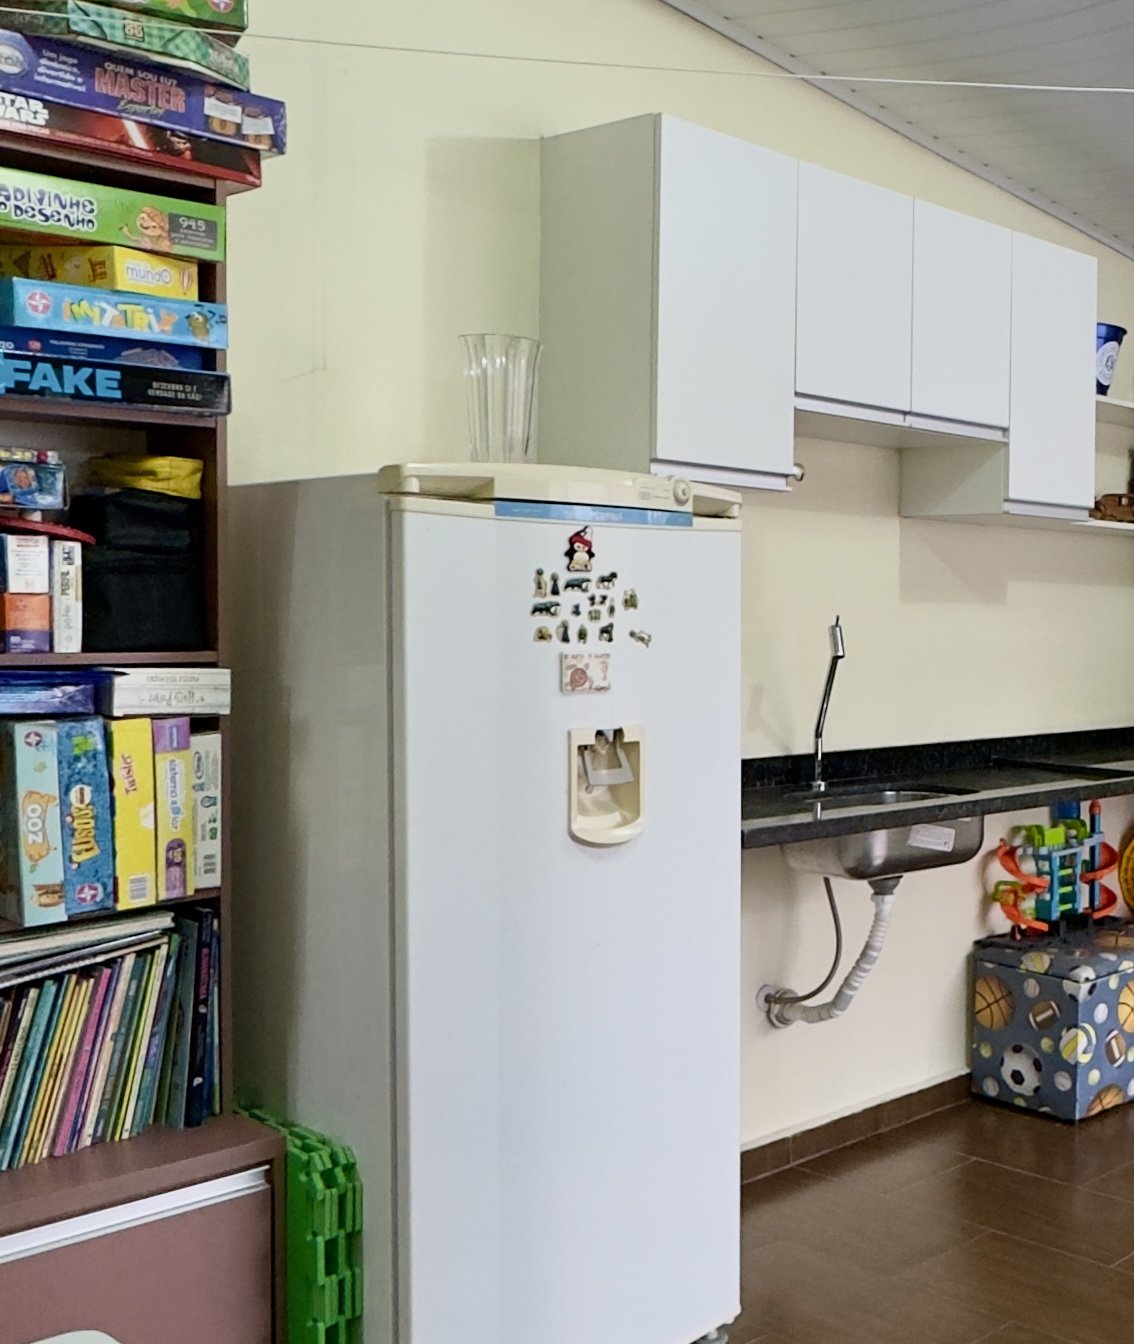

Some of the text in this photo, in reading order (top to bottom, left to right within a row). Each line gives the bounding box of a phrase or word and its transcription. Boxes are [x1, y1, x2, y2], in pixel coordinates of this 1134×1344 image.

[94, 66, 187, 114] MASTER
[104, 61, 135, 76] QUEM
[137, 69, 158, 81] SOU
[0, 91, 49, 115] TAR
[13, 204, 95, 230] DESENHO
[2, 358, 122, 399] FAKE
[118, 753, 138, 795] Twister
[26, 804, 44, 845] ZOO
